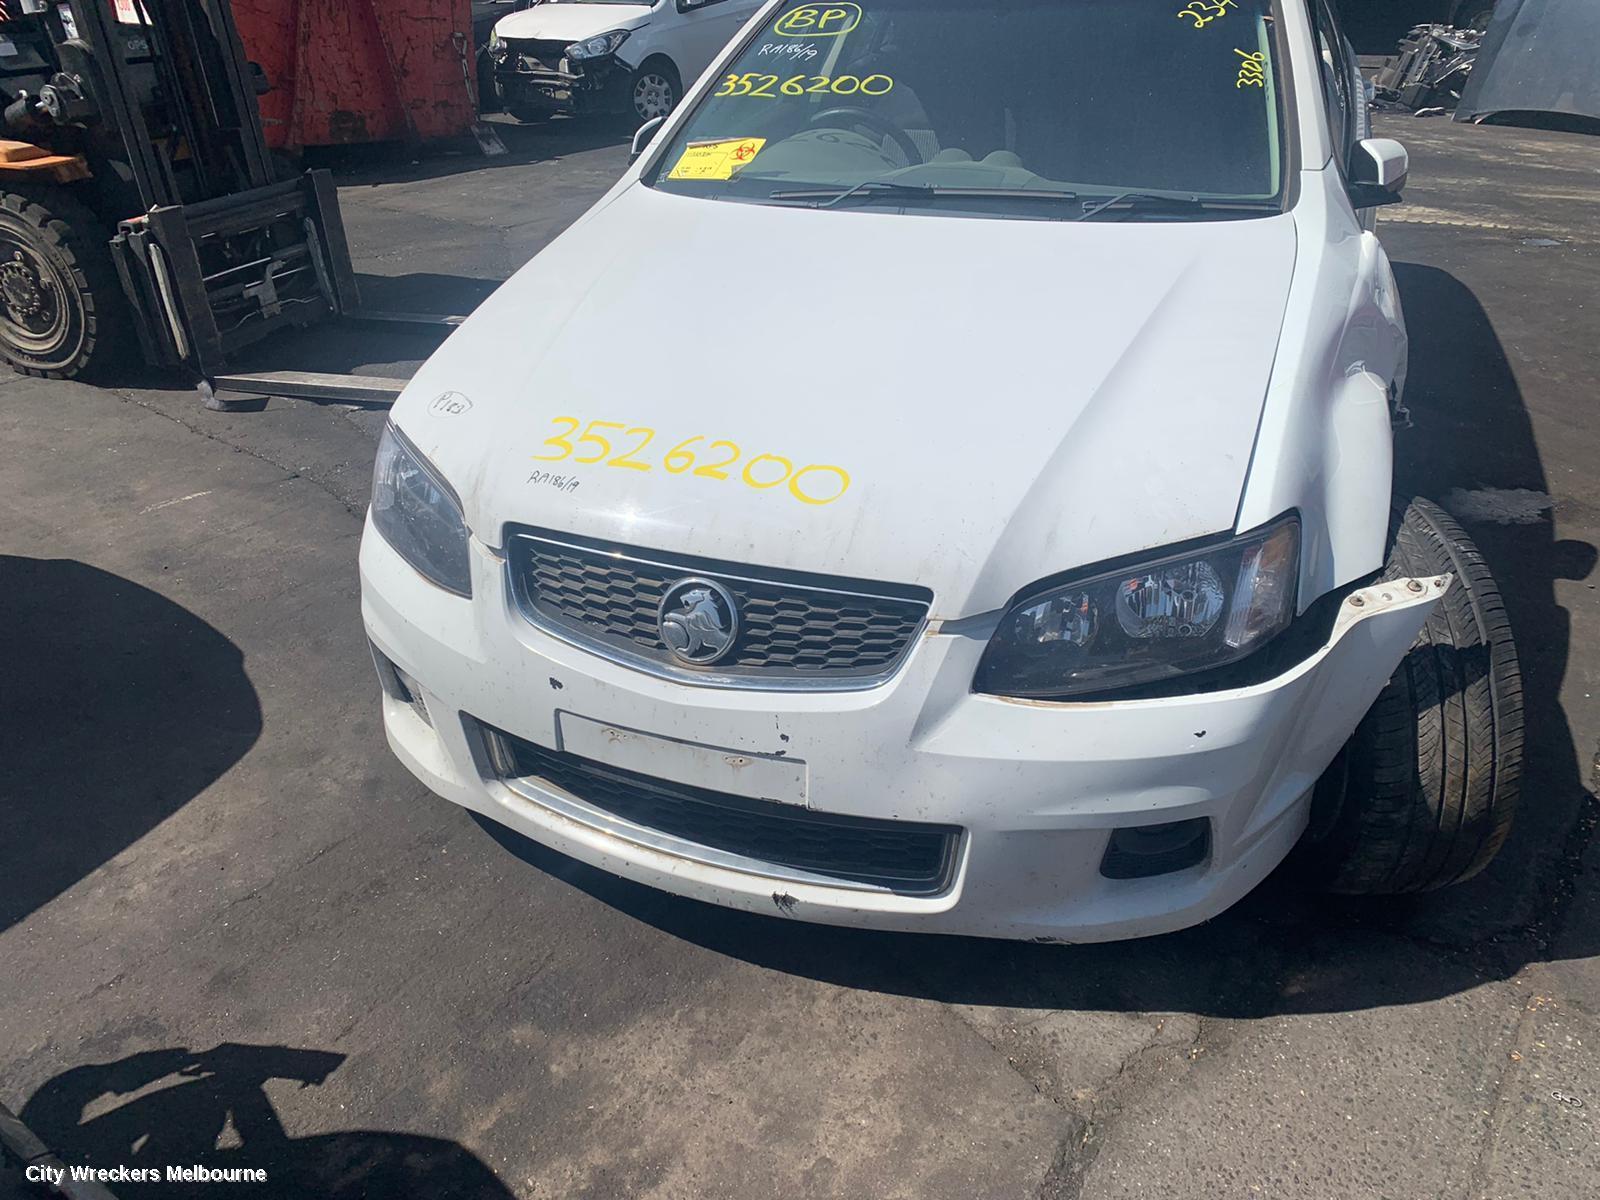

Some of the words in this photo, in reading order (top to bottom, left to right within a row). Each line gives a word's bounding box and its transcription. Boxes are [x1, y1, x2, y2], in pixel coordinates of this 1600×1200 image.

[783, 9, 847, 29] BP
[714, 73, 894, 97] 3526200
[531, 416, 850, 505] 3526200
